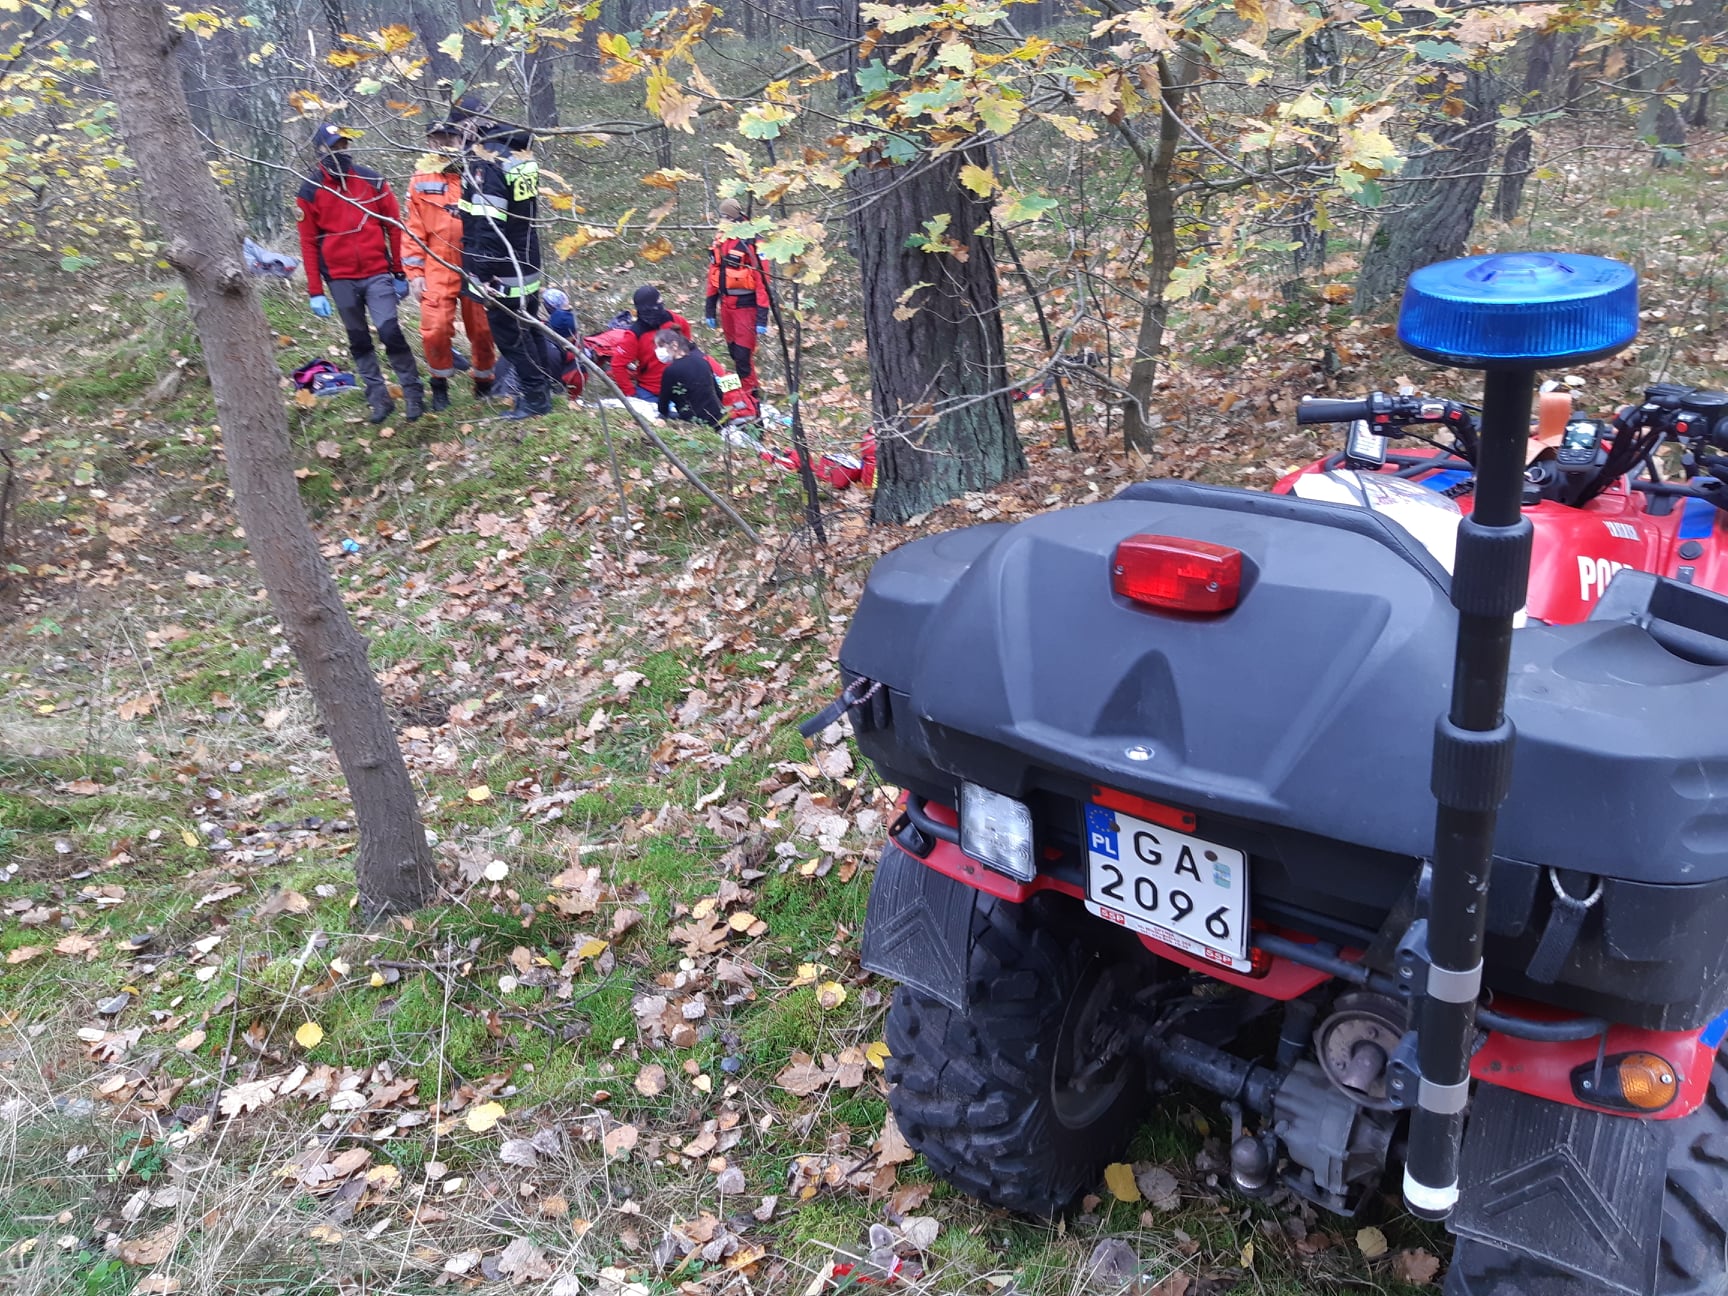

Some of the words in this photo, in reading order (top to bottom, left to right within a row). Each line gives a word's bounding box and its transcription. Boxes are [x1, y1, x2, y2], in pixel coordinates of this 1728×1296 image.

[1577, 555, 1634, 602] PO
[1092, 832, 1117, 856] PL
[1133, 830, 1202, 882] GA
[1100, 907, 1126, 925] SSP
[1101, 864, 1232, 939] 2096
[1205, 947, 1233, 966] SSP
